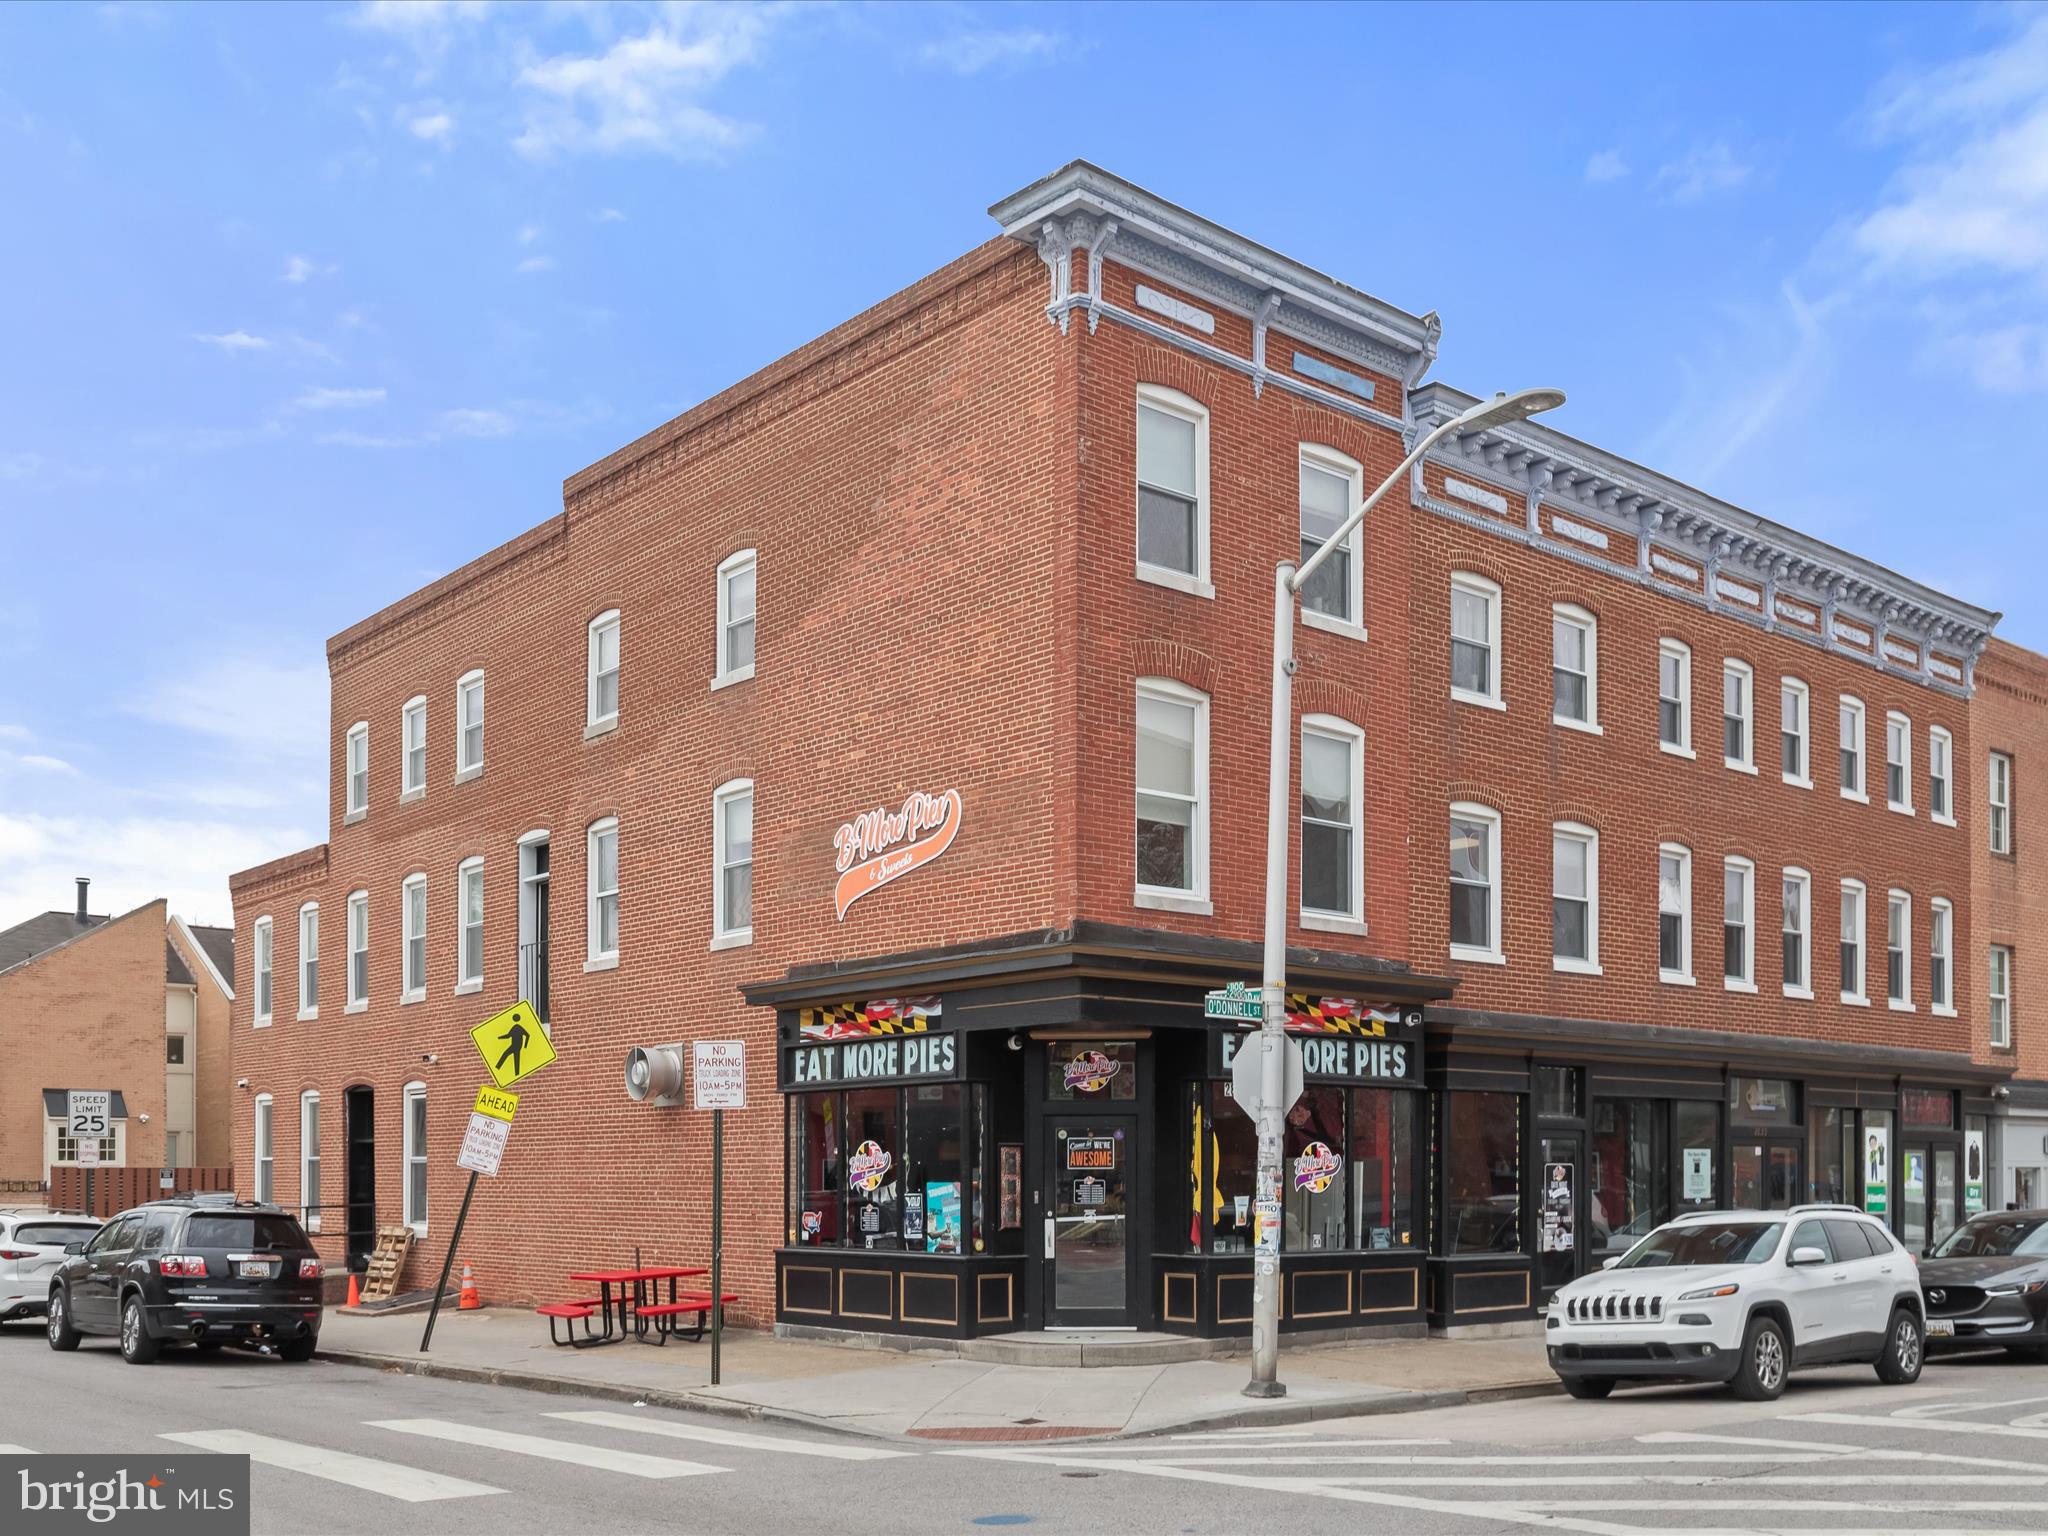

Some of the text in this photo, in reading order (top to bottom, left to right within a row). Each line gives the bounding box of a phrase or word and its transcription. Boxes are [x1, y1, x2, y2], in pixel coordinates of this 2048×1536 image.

[901, 791, 945, 841] Pies
[878, 853, 913, 879] Sweets
[1208, 999, 1253, 1017] O'DONNELL
[712, 1046, 727, 1056] NO
[795, 1035, 955, 1082] EAT MORE PIES
[698, 1057, 741, 1067] PARKING
[1354, 1041, 1407, 1078] PIES
[699, 1080, 742, 1091] 10AM-5PM
[72, 1095, 107, 1104] SPEED
[478, 1094, 515, 1113] AHEAD
[75, 1105, 103, 1113] LIMIT
[73, 1115, 105, 1132] 25
[483, 1120, 496, 1130] NO
[470, 1127, 504, 1142] PARKING
[1070, 1150, 1112, 1166] AWESOME
